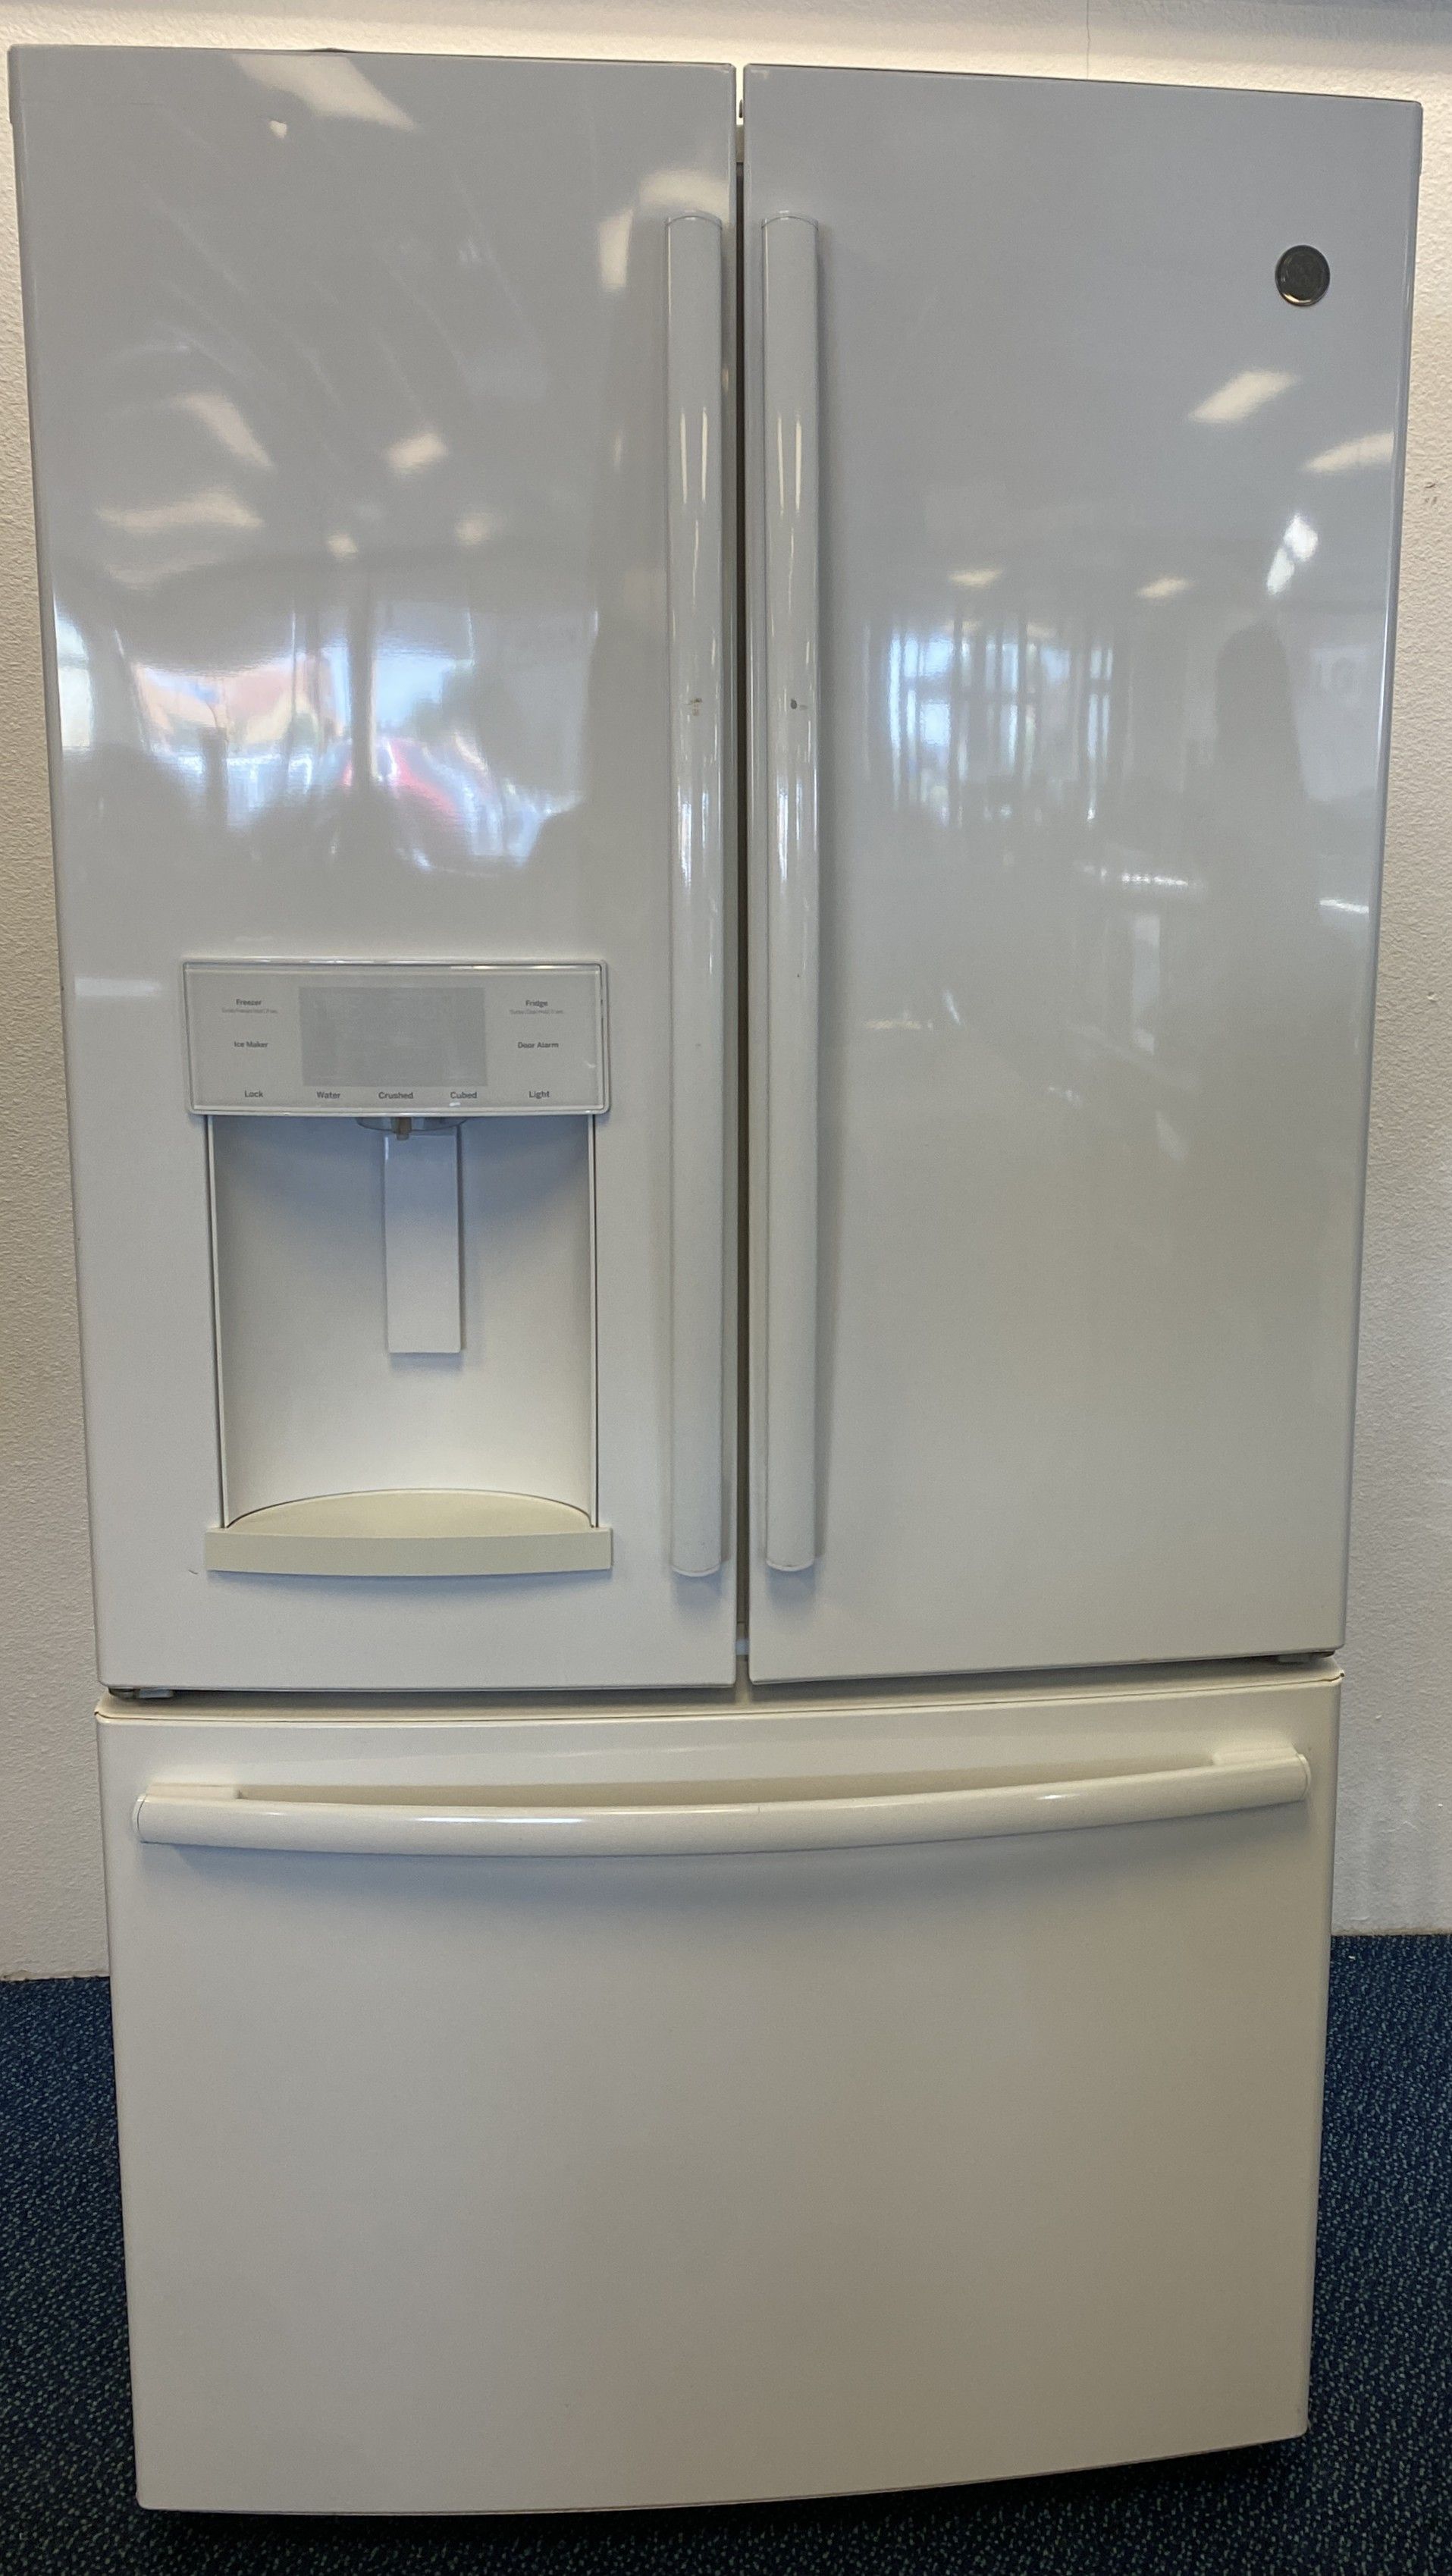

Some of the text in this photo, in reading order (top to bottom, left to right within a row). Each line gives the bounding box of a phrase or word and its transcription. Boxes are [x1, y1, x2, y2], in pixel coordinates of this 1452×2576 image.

[525, 999, 548, 1009] Fridge
[244, 1090, 264, 1098] Lock
[316, 1091, 341, 1100] Water
[378, 1091, 414, 1100] Crushed
[450, 1091, 478, 1100] Cubed
[528, 1090, 550, 1100] Light
